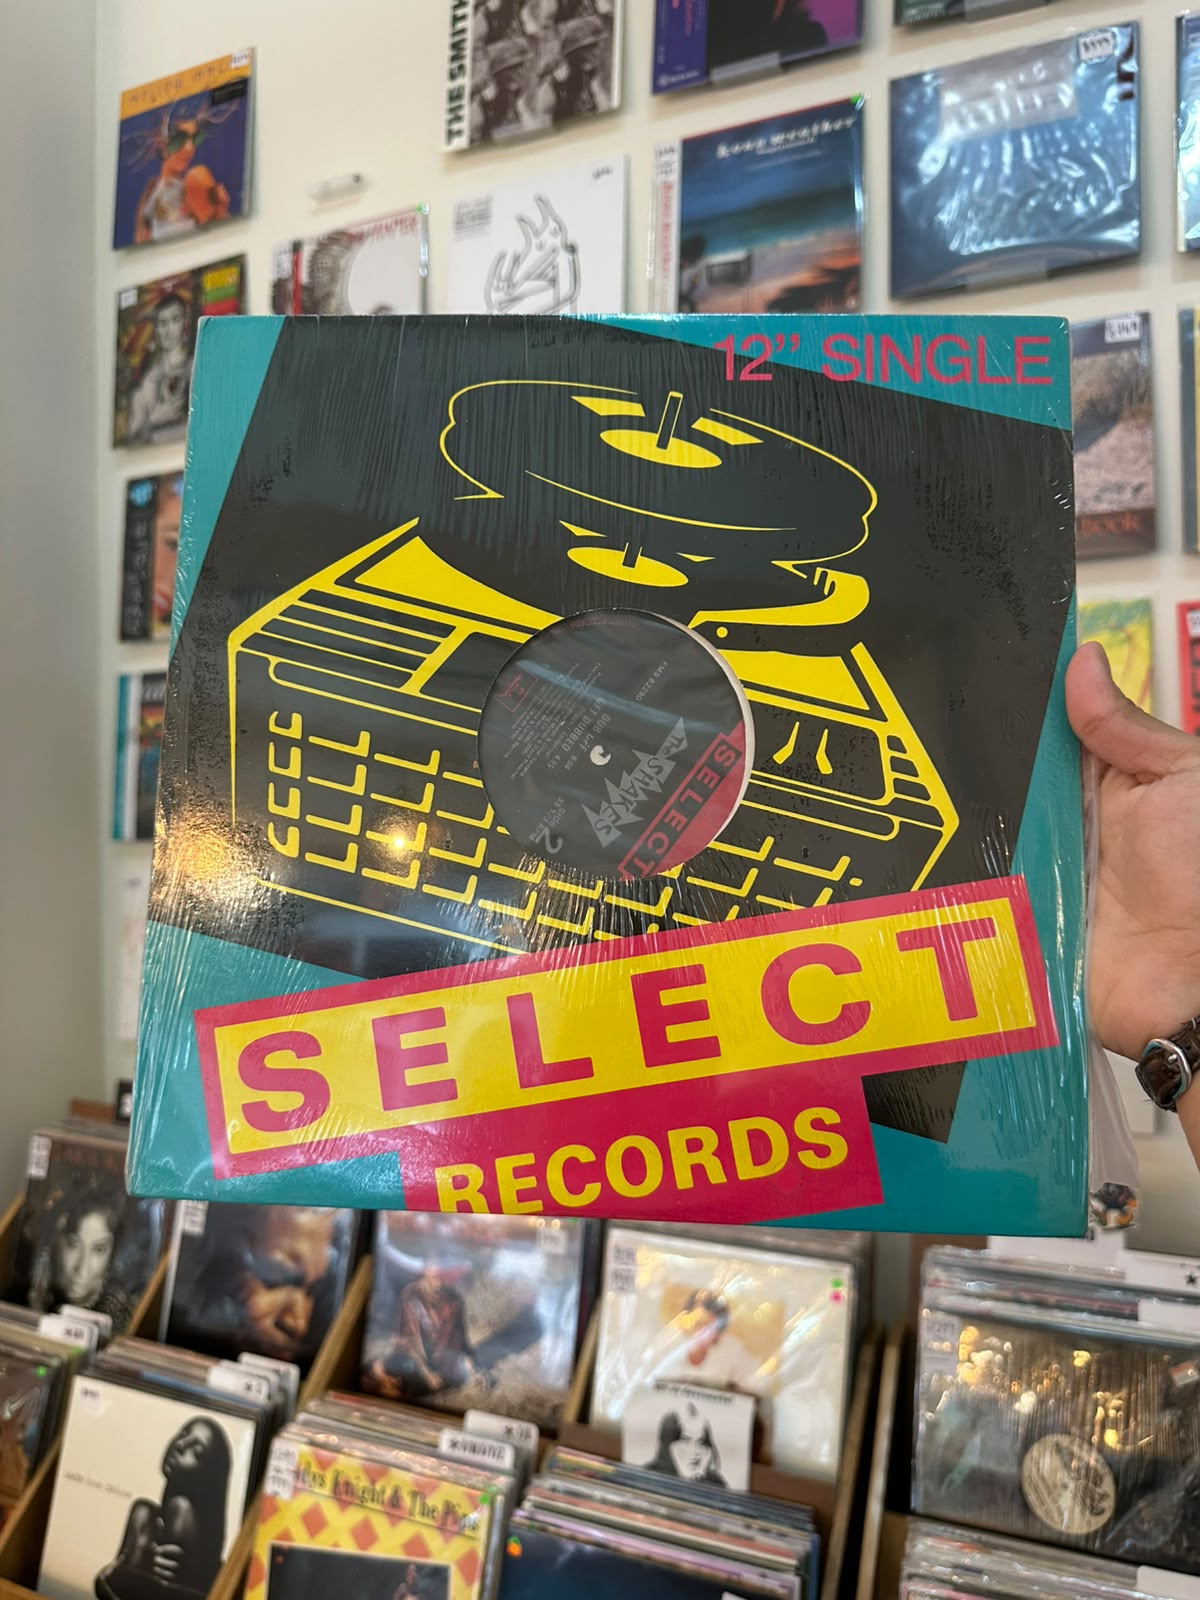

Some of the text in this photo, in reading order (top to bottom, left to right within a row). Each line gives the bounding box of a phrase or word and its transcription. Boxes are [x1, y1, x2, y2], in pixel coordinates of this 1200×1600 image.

[446, 84, 465, 146] THE
[821, 333, 1053, 385] SINGLE
[560, 714, 592, 752] DUBBED
[591, 712, 610, 734] DUB
[594, 731, 685, 839] The SHAKES
[633, 746, 736, 878] SELECT
[533, 825, 564, 855] 2
[237, 916, 997, 1133] SELECT
[434, 1106, 849, 1214] RECORDS
[330, 1467, 387, 1506] Knight
[406, 1488, 440, 1520] The
